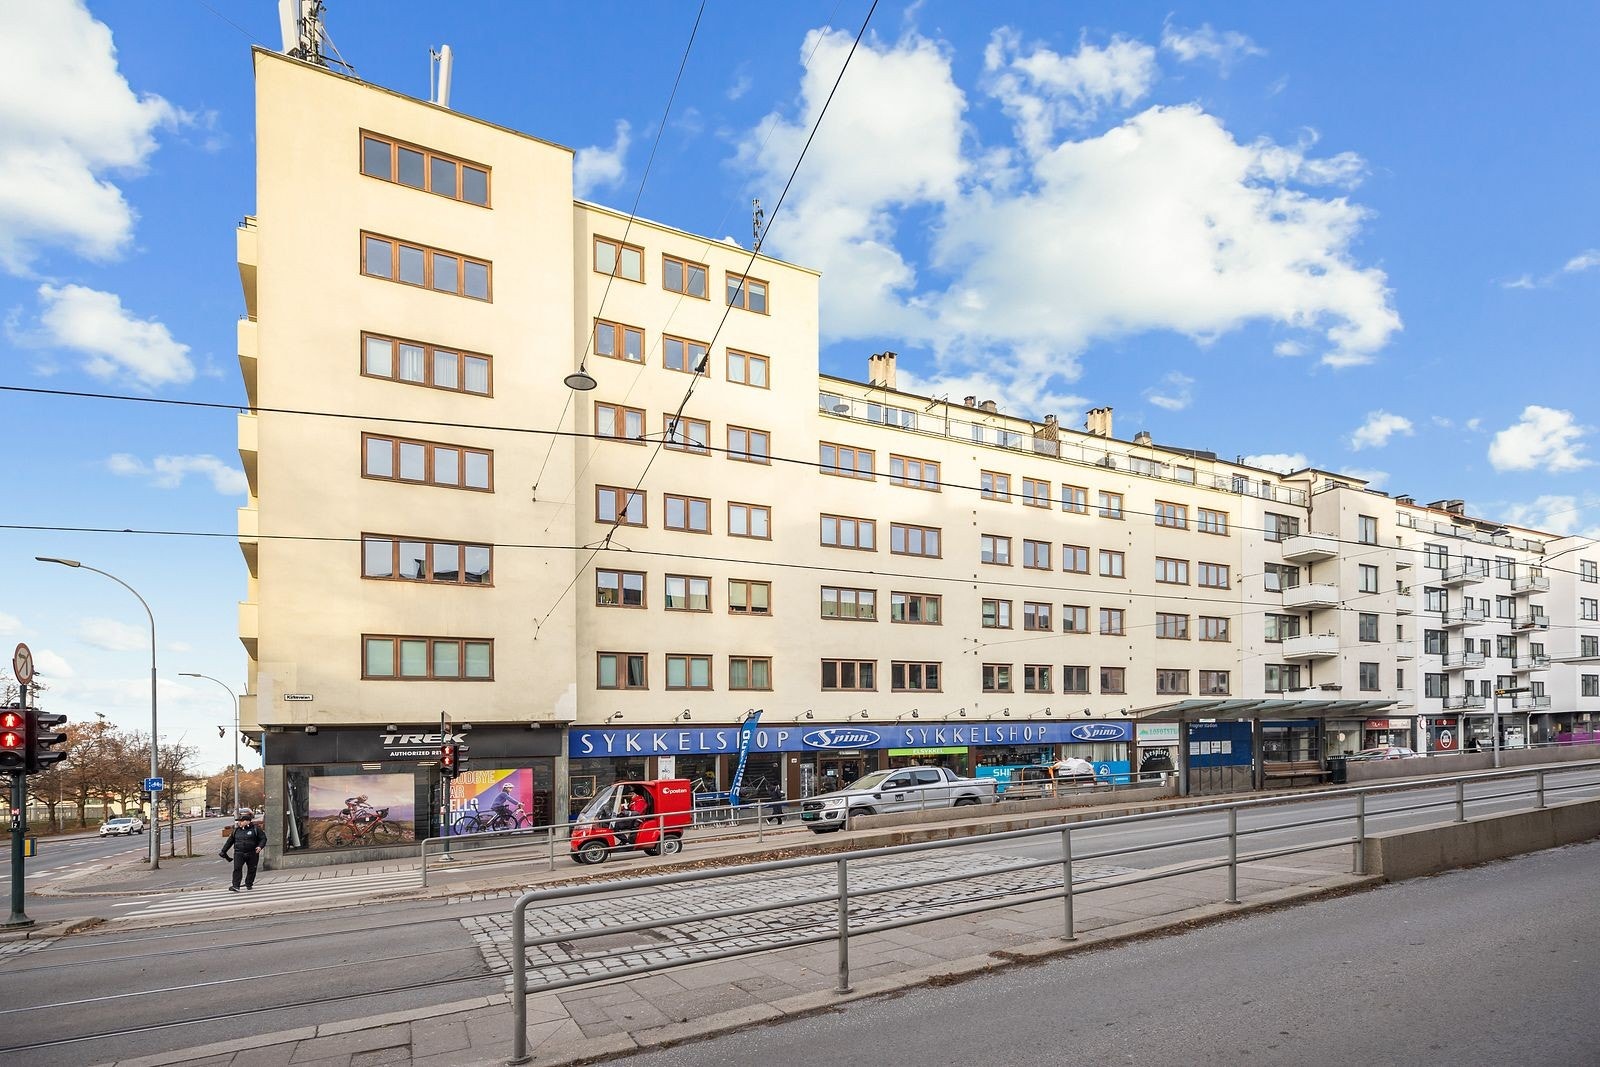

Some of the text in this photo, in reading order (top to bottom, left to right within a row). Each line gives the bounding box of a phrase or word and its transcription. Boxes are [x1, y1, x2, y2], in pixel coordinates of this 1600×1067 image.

[380, 733, 468, 744] TREK
[813, 729, 869, 746] Spinn
[905, 726, 1047, 745] SYKKELSHOP
[1078, 724, 1118, 740] Spinn
[448, 798, 479, 813] ELLO
